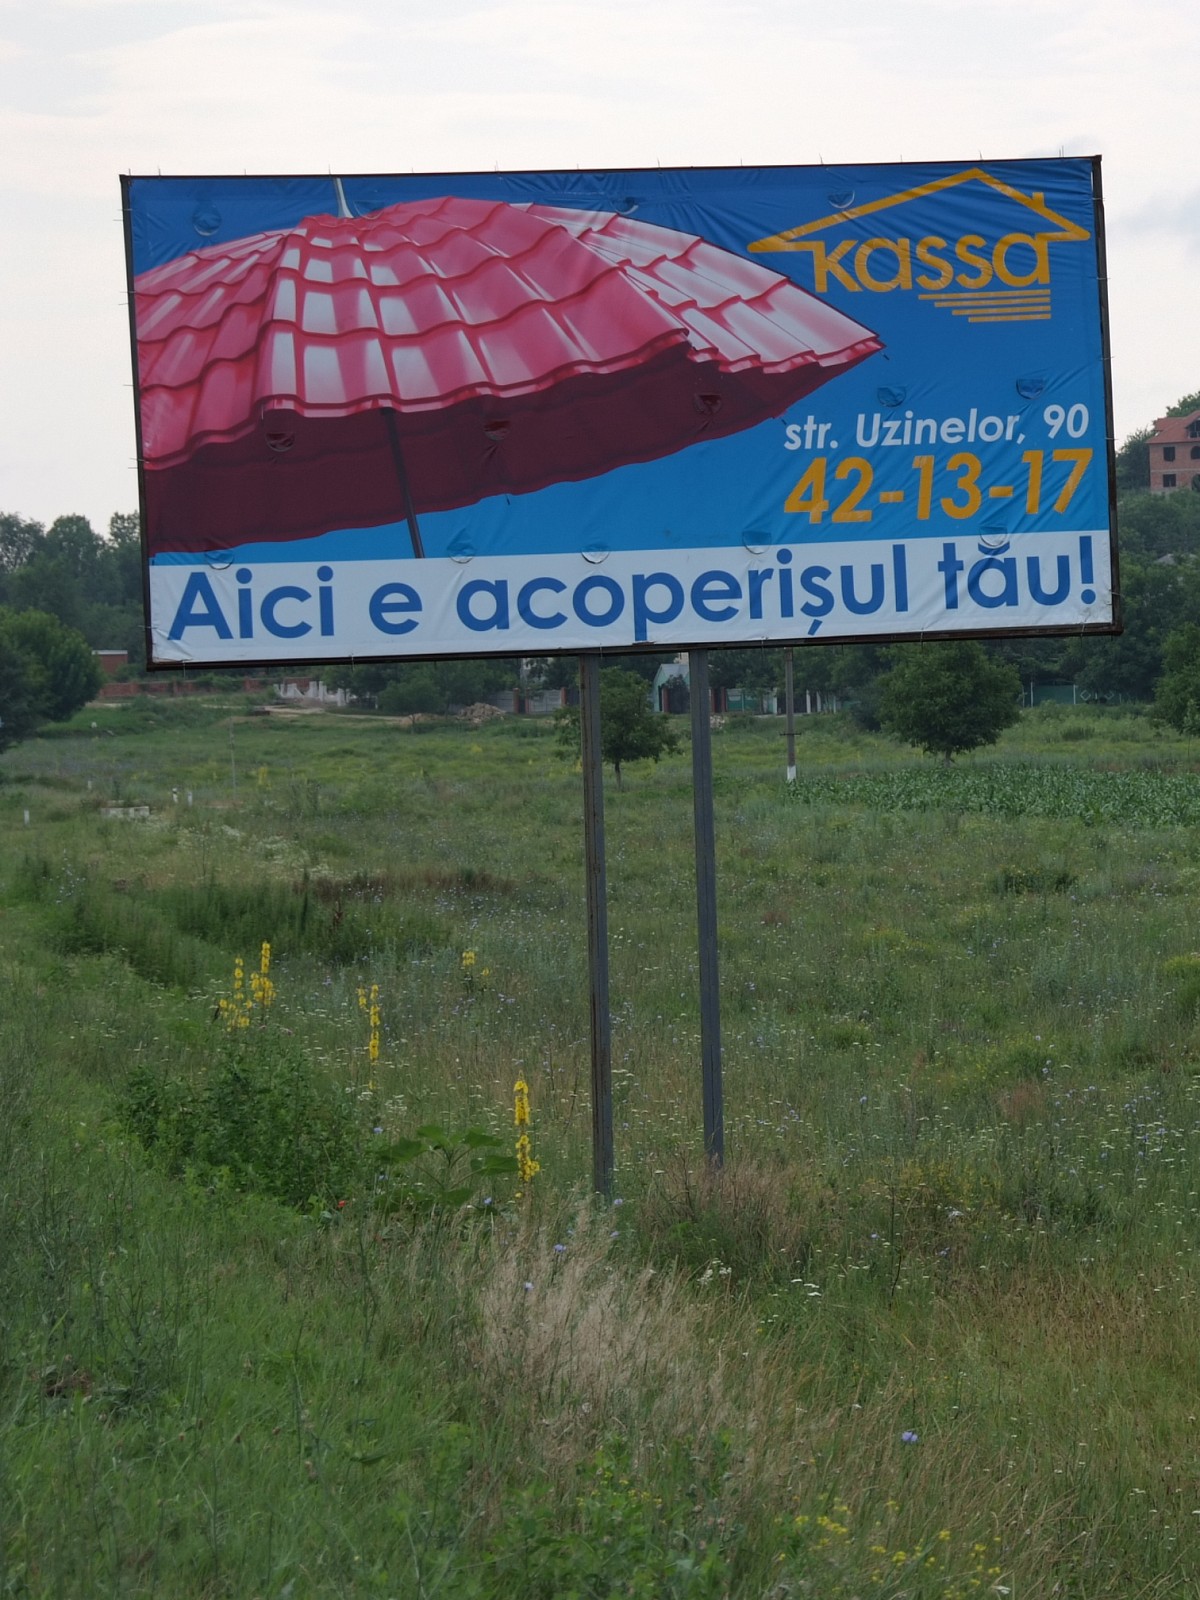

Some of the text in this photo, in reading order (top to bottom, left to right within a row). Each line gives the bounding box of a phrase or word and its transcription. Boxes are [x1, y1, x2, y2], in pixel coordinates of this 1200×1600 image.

[784, 403, 1089, 451] str. Uzinelor, 90
[784, 448, 1093, 525] 42-13-17
[167, 535, 1097, 642] Aici e acoperișul tău!
